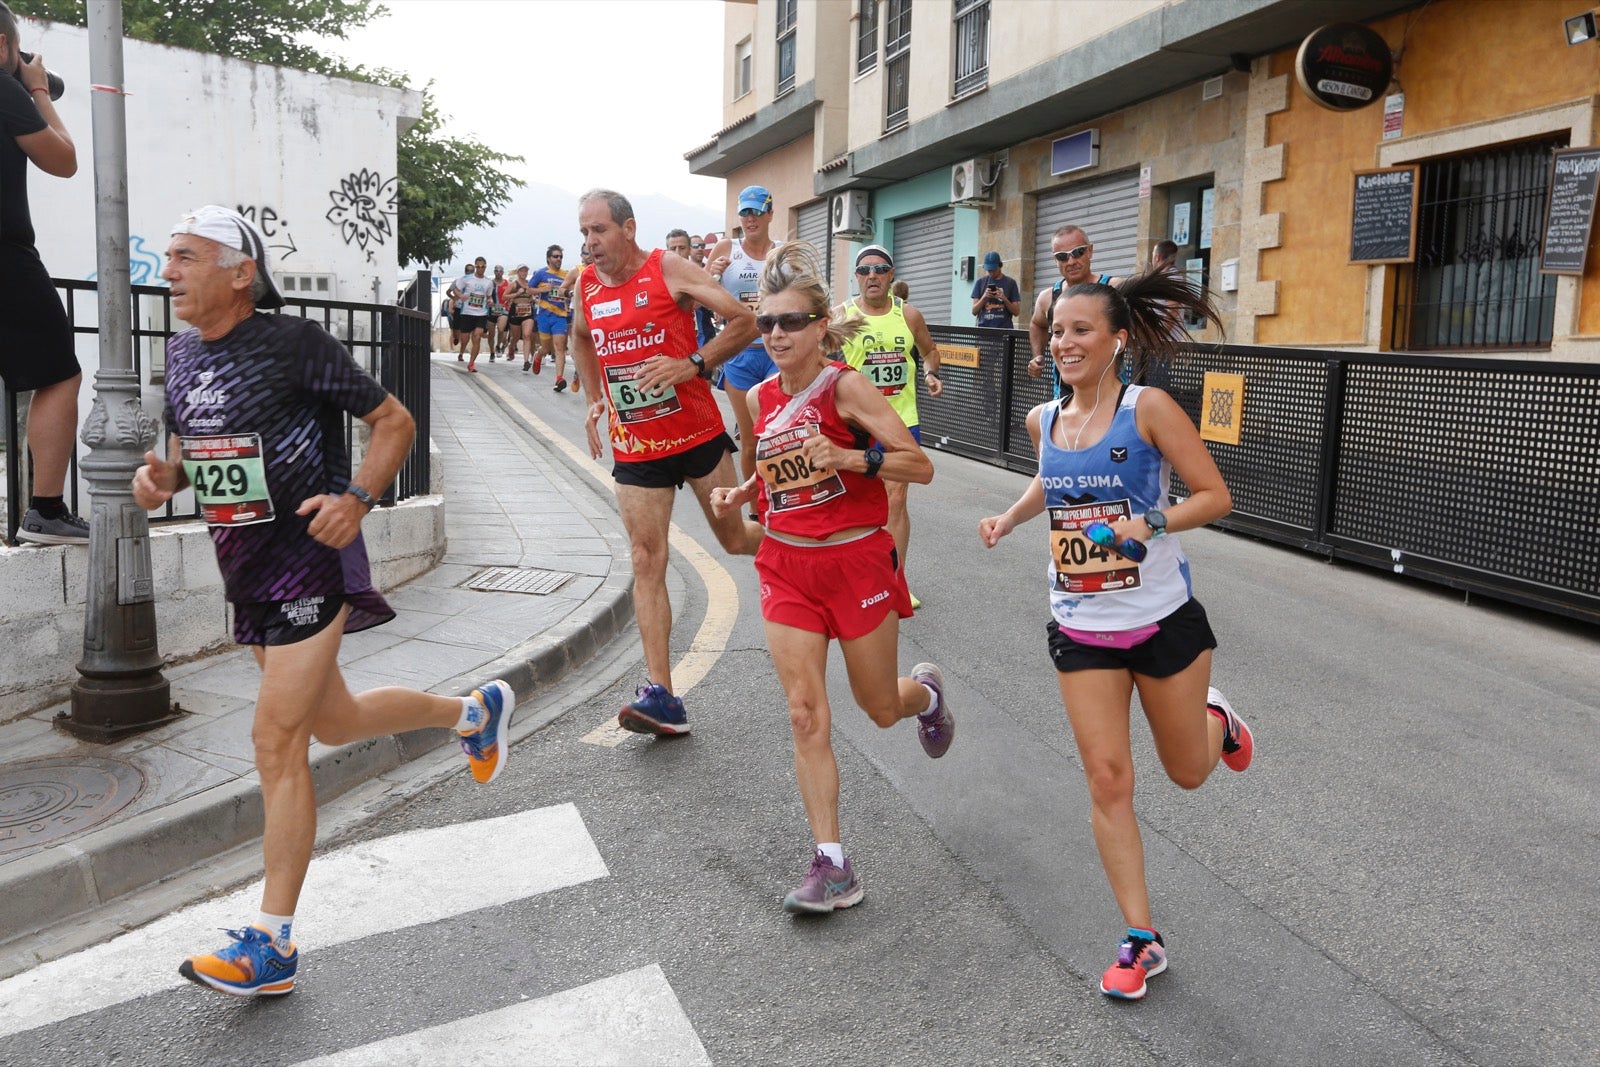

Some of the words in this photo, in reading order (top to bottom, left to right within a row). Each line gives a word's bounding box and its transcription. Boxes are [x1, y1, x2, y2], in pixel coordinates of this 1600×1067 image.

[739, 272, 758, 280] MAR
[591, 328, 666, 357] Polisalud
[871, 365, 903, 383] 139
[194, 463, 248, 497] 429
[1041, 476, 1073, 490] TODO
[1077, 474, 1123, 488] SUMA
[1069, 507, 1092, 520] PREMIO
[1093, 506, 1101, 517] DE
[1102, 504, 1124, 516] FONDO
[1059, 537, 1123, 566] 204
